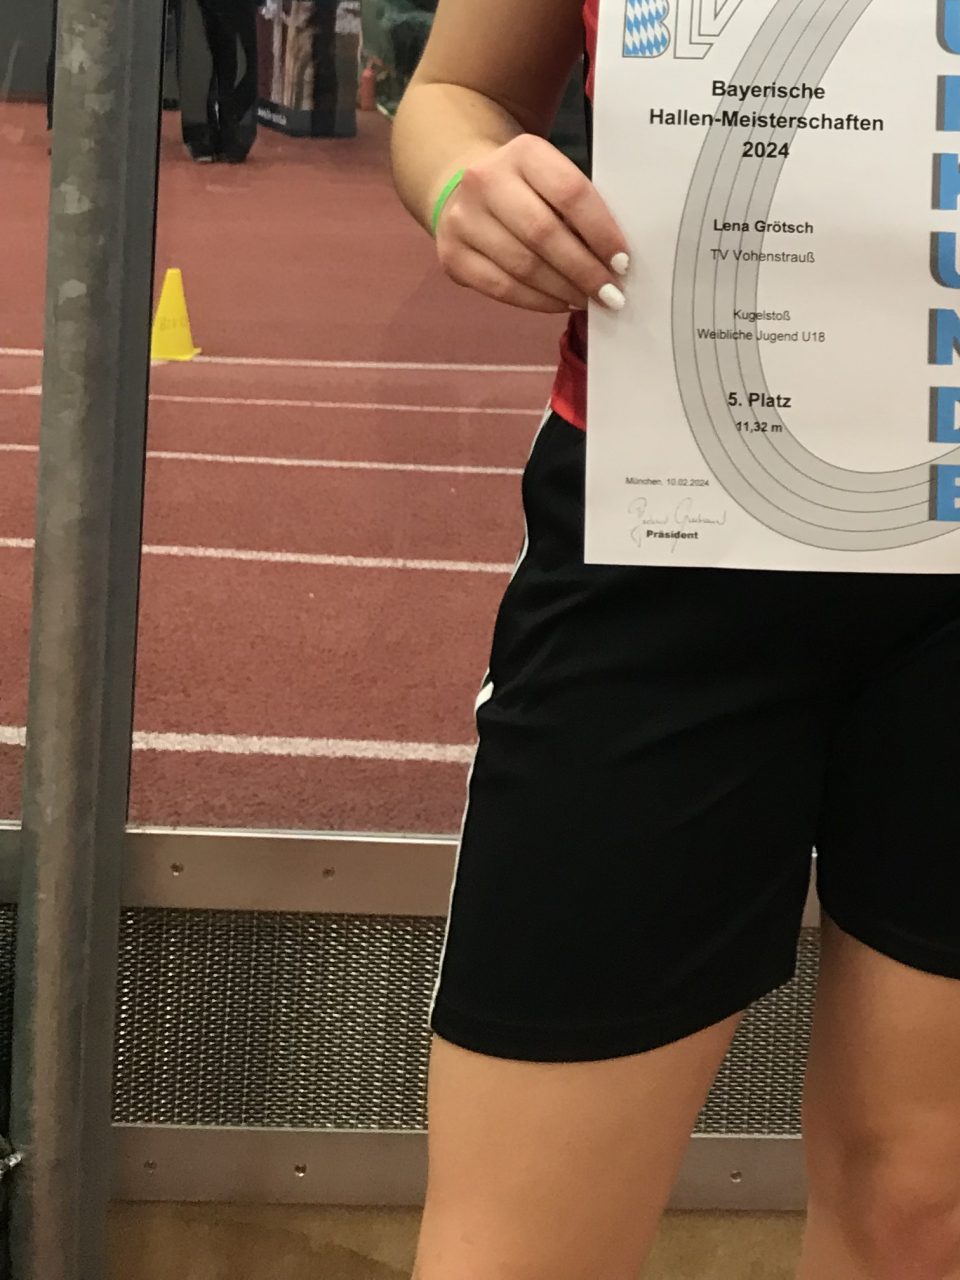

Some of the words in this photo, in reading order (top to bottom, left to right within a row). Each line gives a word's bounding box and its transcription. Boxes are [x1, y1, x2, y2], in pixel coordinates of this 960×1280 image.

[711, 80, 826, 101] Bayerische
[649, 108, 885, 132] Hallen-Meisterschaften
[742, 141, 790, 159] 2024
[713, 218, 750, 233] Lena
[754, 218, 815, 235] Grötsch
[711, 248, 730, 262] TV
[732, 248, 816, 264] Vohenstrauß
[733, 308, 792, 324] Kugelstoß
[697, 327, 753, 342] Weibliche
[756, 328, 799, 345] Jugend
[802, 330, 826, 343] U18
[727, 392, 744, 409] 5.
[748, 392, 793, 409] Platz
[735, 421, 768, 435] 11,32
[770, 423, 784, 434] m
[667, 478, 710, 488] 10.02.2024
[646, 529, 699, 539] Präsident
